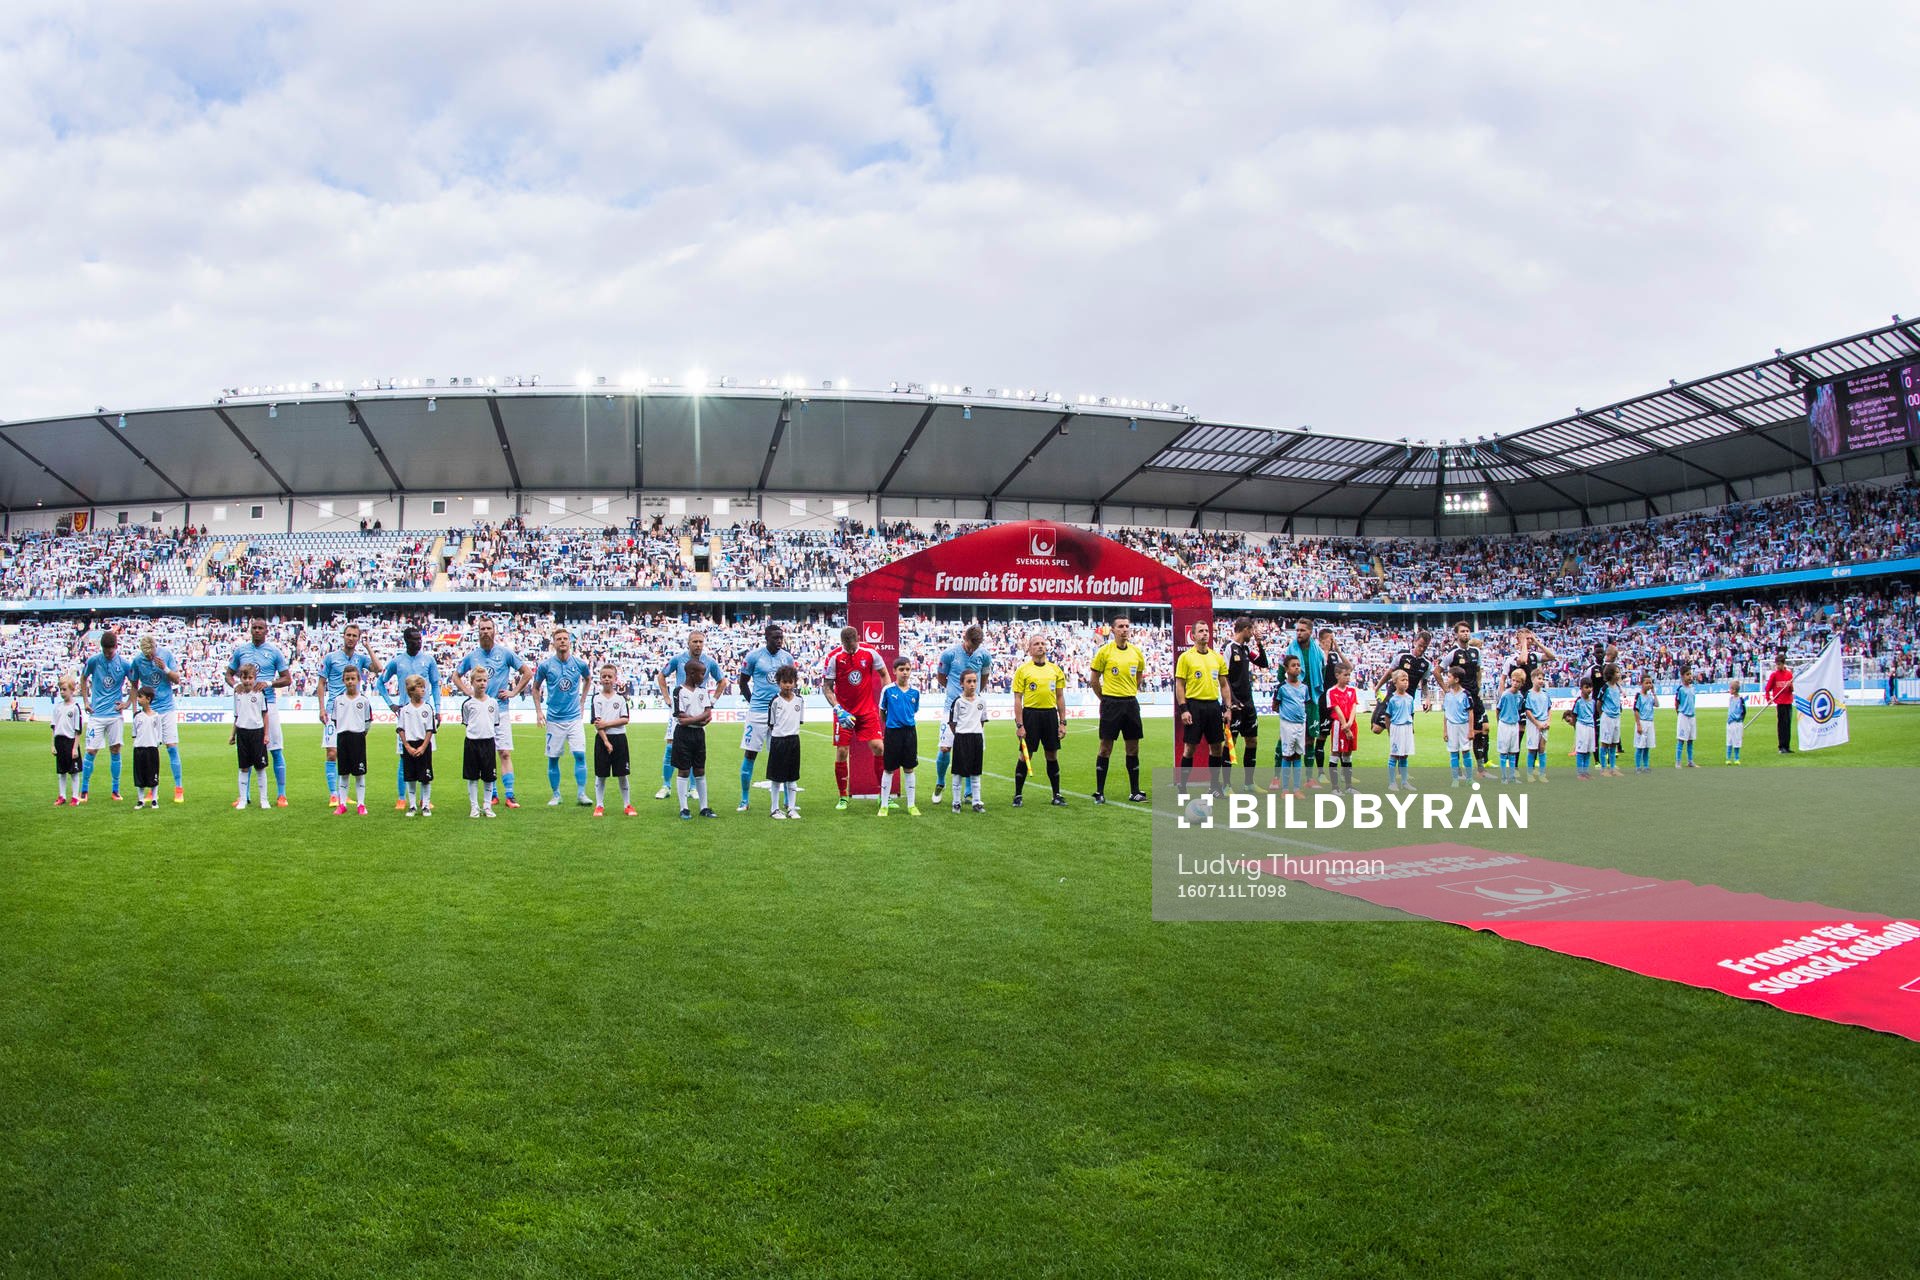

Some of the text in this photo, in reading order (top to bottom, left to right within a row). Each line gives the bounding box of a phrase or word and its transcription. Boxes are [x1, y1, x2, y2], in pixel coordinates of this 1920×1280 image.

[1905, 376, 1912, 388] 0
[1016, 558, 1070, 567] SVENSKA SPEL
[935, 572, 1144, 596] Framåt för svensk fotboll!
[745, 724, 753, 737] 2
[547, 733, 552, 744] 7
[1717, 922, 1869, 975] Framåt för
[1748, 955, 1858, 994] svensk
